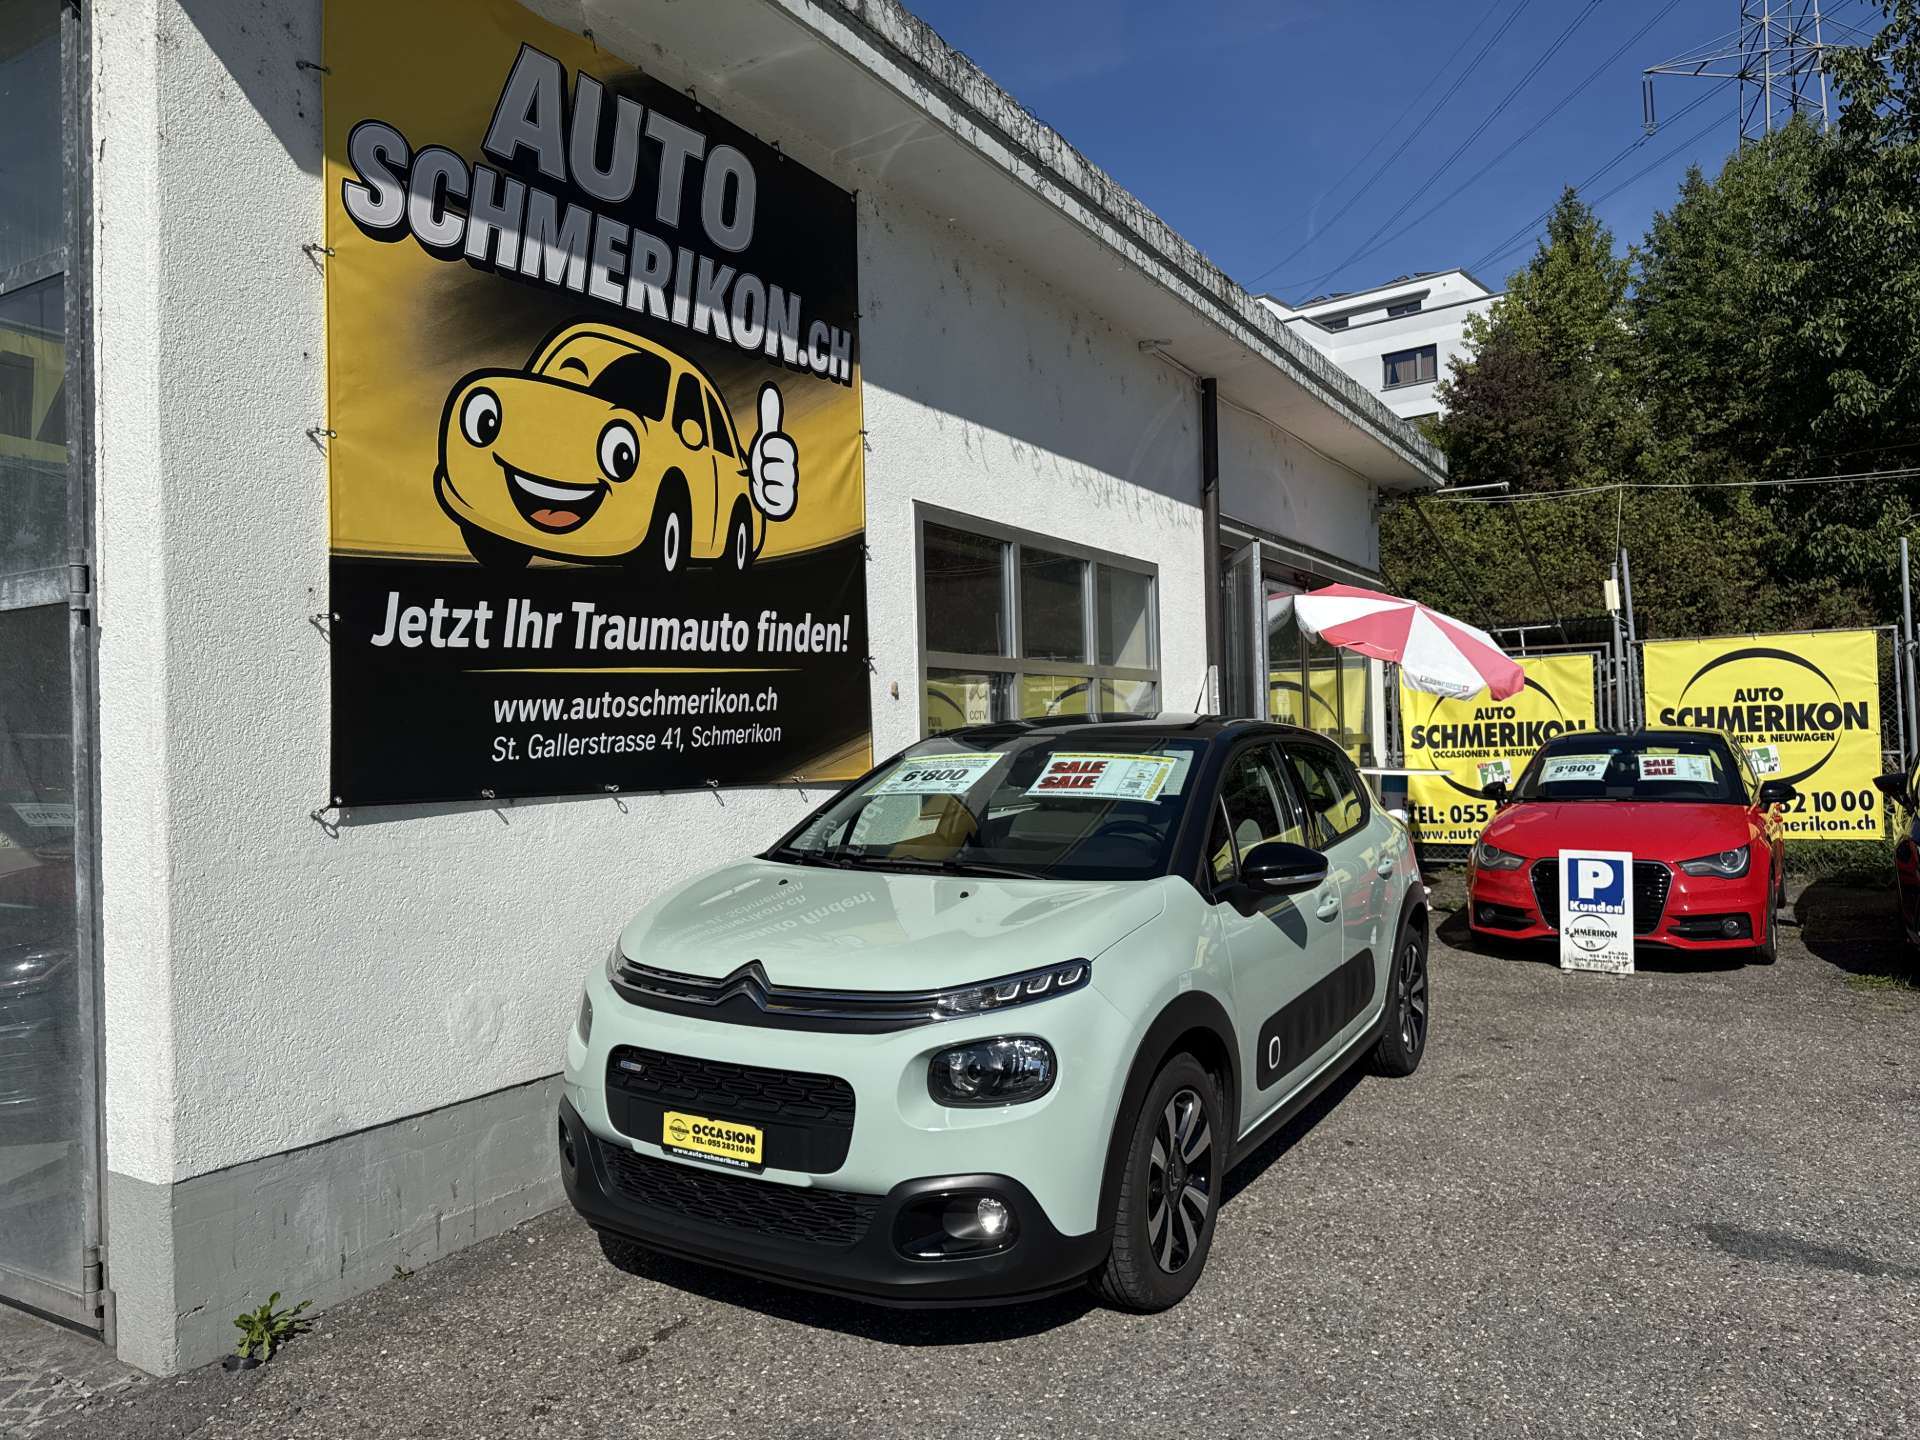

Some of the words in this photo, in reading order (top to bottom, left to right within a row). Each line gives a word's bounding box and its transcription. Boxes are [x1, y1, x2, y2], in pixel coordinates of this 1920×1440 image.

[483, 42, 757, 253] AUTO
[342, 121, 852, 382] SCHMERIKON.CH
[371, 592, 493, 649] Jetzt
[503, 598, 562, 649] Ihr
[571, 602, 749, 652] Traumauto
[757, 613, 851, 652] finden!
[1734, 687, 1784, 703] AUTO
[493, 687, 778, 723] www.autoschmerikon.ch
[1474, 706, 1516, 721] AUTO
[1659, 701, 1869, 732] SCHMERIKON
[492, 736, 520, 762] St.
[528, 730, 656, 760] Gallerstrasse
[661, 727, 685, 753] 41,
[691, 723, 781, 748] Schmerikon
[1757, 734, 1766, 743] &
[1770, 732, 1835, 743] NEUWAGEN
[1433, 749, 1490, 759] OCCASIONEN
[1493, 749, 1500, 758] &
[1504, 748, 1538, 758] NEUWA
[1048, 761, 1109, 774] SALE
[1643, 759, 1675, 767] SALE
[902, 769, 969, 782] 6'800
[1037, 776, 1100, 789] SALE
[1408, 805, 1444, 824] TEL:
[1450, 804, 1488, 824] 055
[1578, 860, 1614, 899] P
[1570, 900, 1623, 913] Kunden
[692, 1124, 756, 1146] OCCASION
[692, 1136, 707, 1145] TEL:
[707, 1138, 721, 1148] 055
[672, 1147, 749, 1168] www.auto-schmerikon.ch
